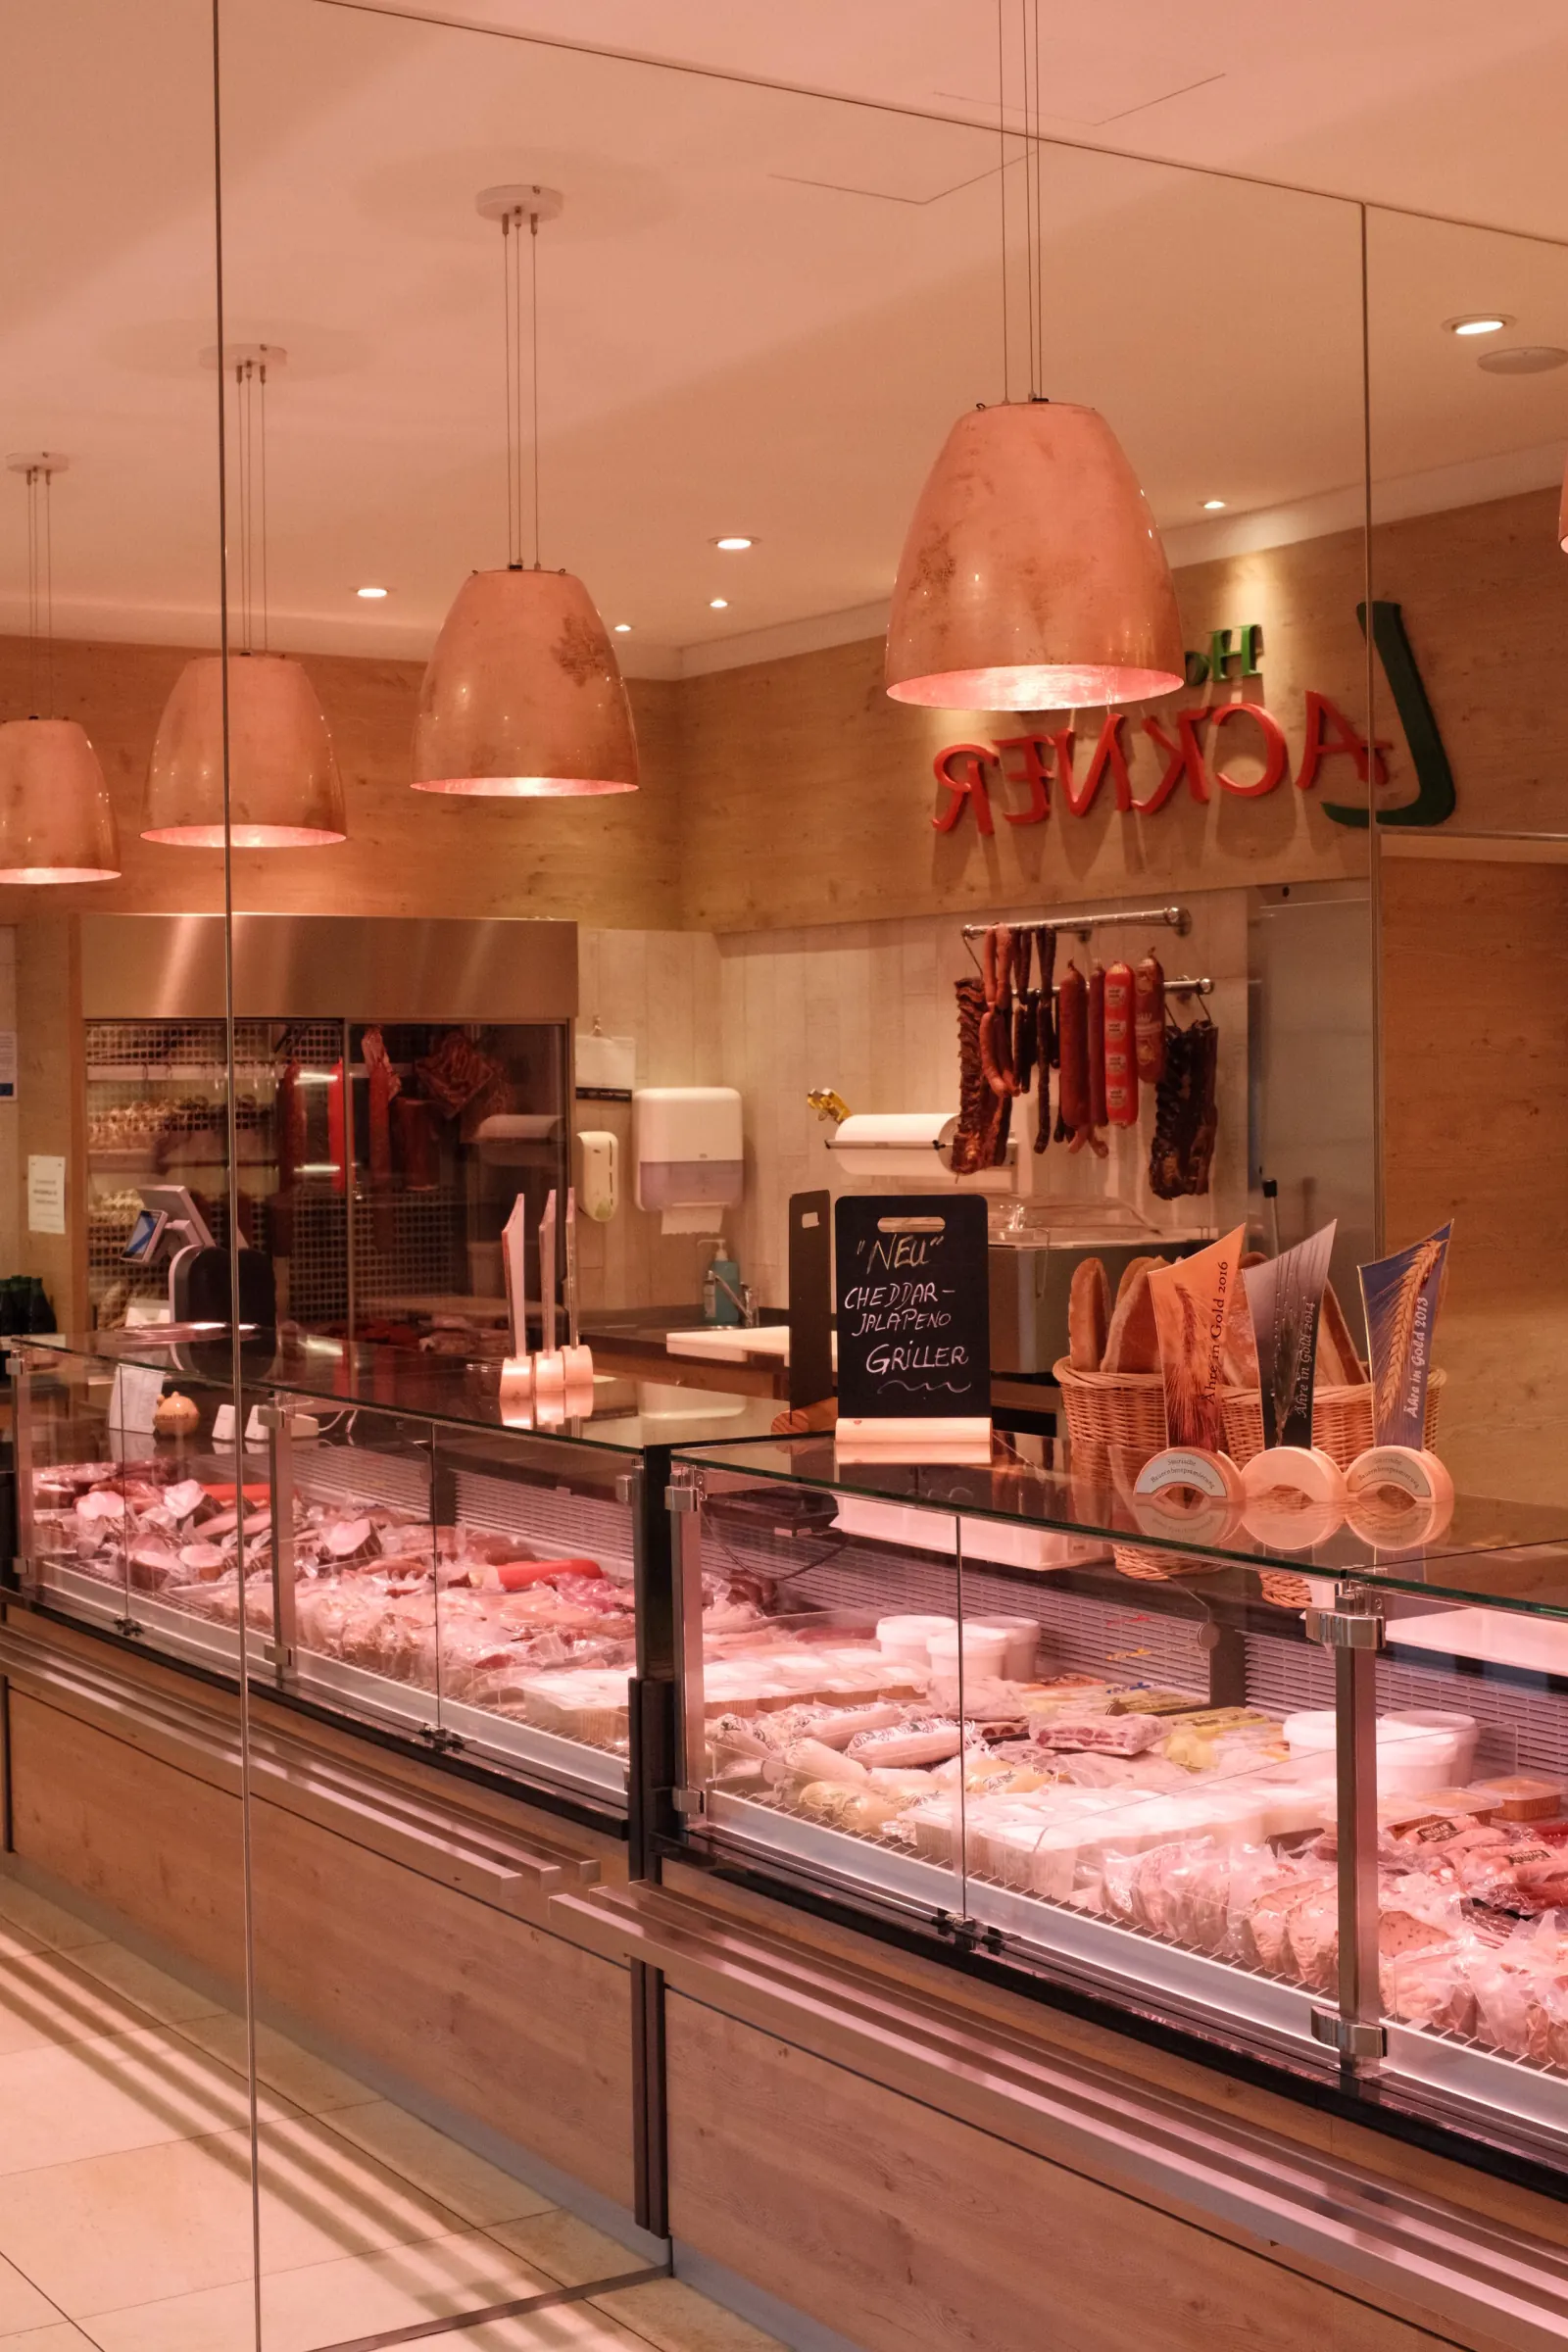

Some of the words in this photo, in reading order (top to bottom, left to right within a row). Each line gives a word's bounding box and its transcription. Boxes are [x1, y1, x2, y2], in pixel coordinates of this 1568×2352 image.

[1218, 1261, 1228, 1294] 2016
[851, 1308, 952, 1337] JALAPENO
[1210, 1298, 1225, 1340] Gold
[1304, 1302, 1315, 1330] 2014
[1414, 1297, 1429, 1328] 2013
[1208, 1345, 1220, 1360] in
[1299, 1332, 1312, 1363] Gold
[1411, 1331, 1425, 1366] Gold
[1200, 1365, 1217, 1405] Ähre
[1301, 1367, 1309, 1381] in
[1409, 1370, 1422, 1383] in
[1295, 1384, 1308, 1418] Ähre
[1403, 1386, 1420, 1418] Ähre
